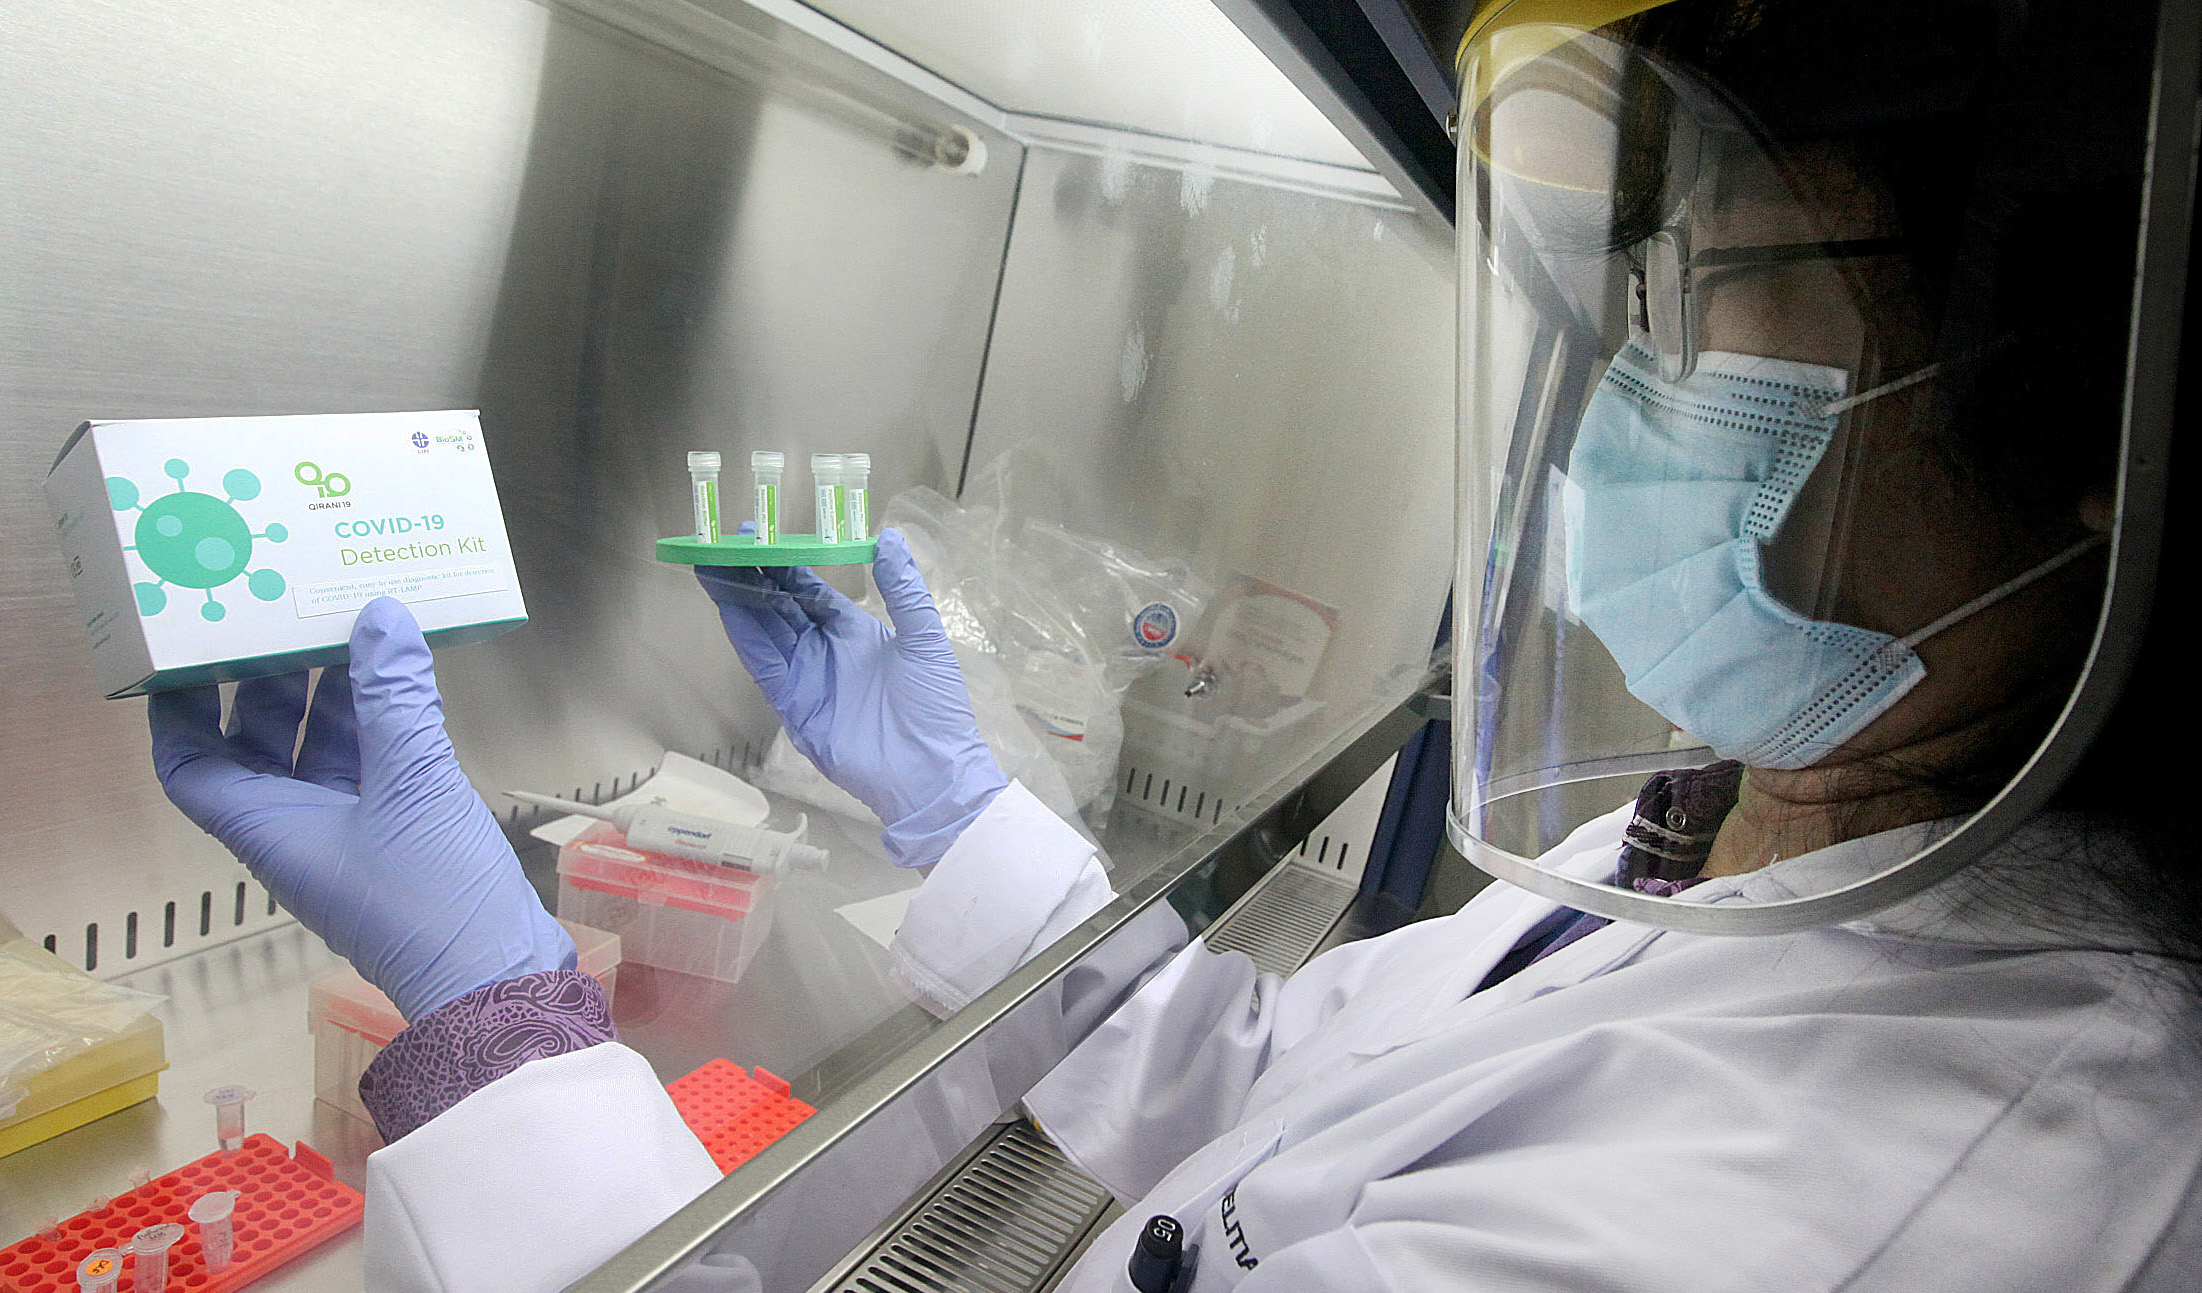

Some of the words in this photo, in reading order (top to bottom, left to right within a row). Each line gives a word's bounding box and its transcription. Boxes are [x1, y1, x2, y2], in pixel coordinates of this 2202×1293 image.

[308, 501, 342, 511] QIRANI
[342, 500, 352, 509] 19
[334, 513, 445, 539] COVID-19
[340, 540, 452, 566] Detection
[457, 535, 487, 554] Kit
[321, 591, 363, 603] COVID-19
